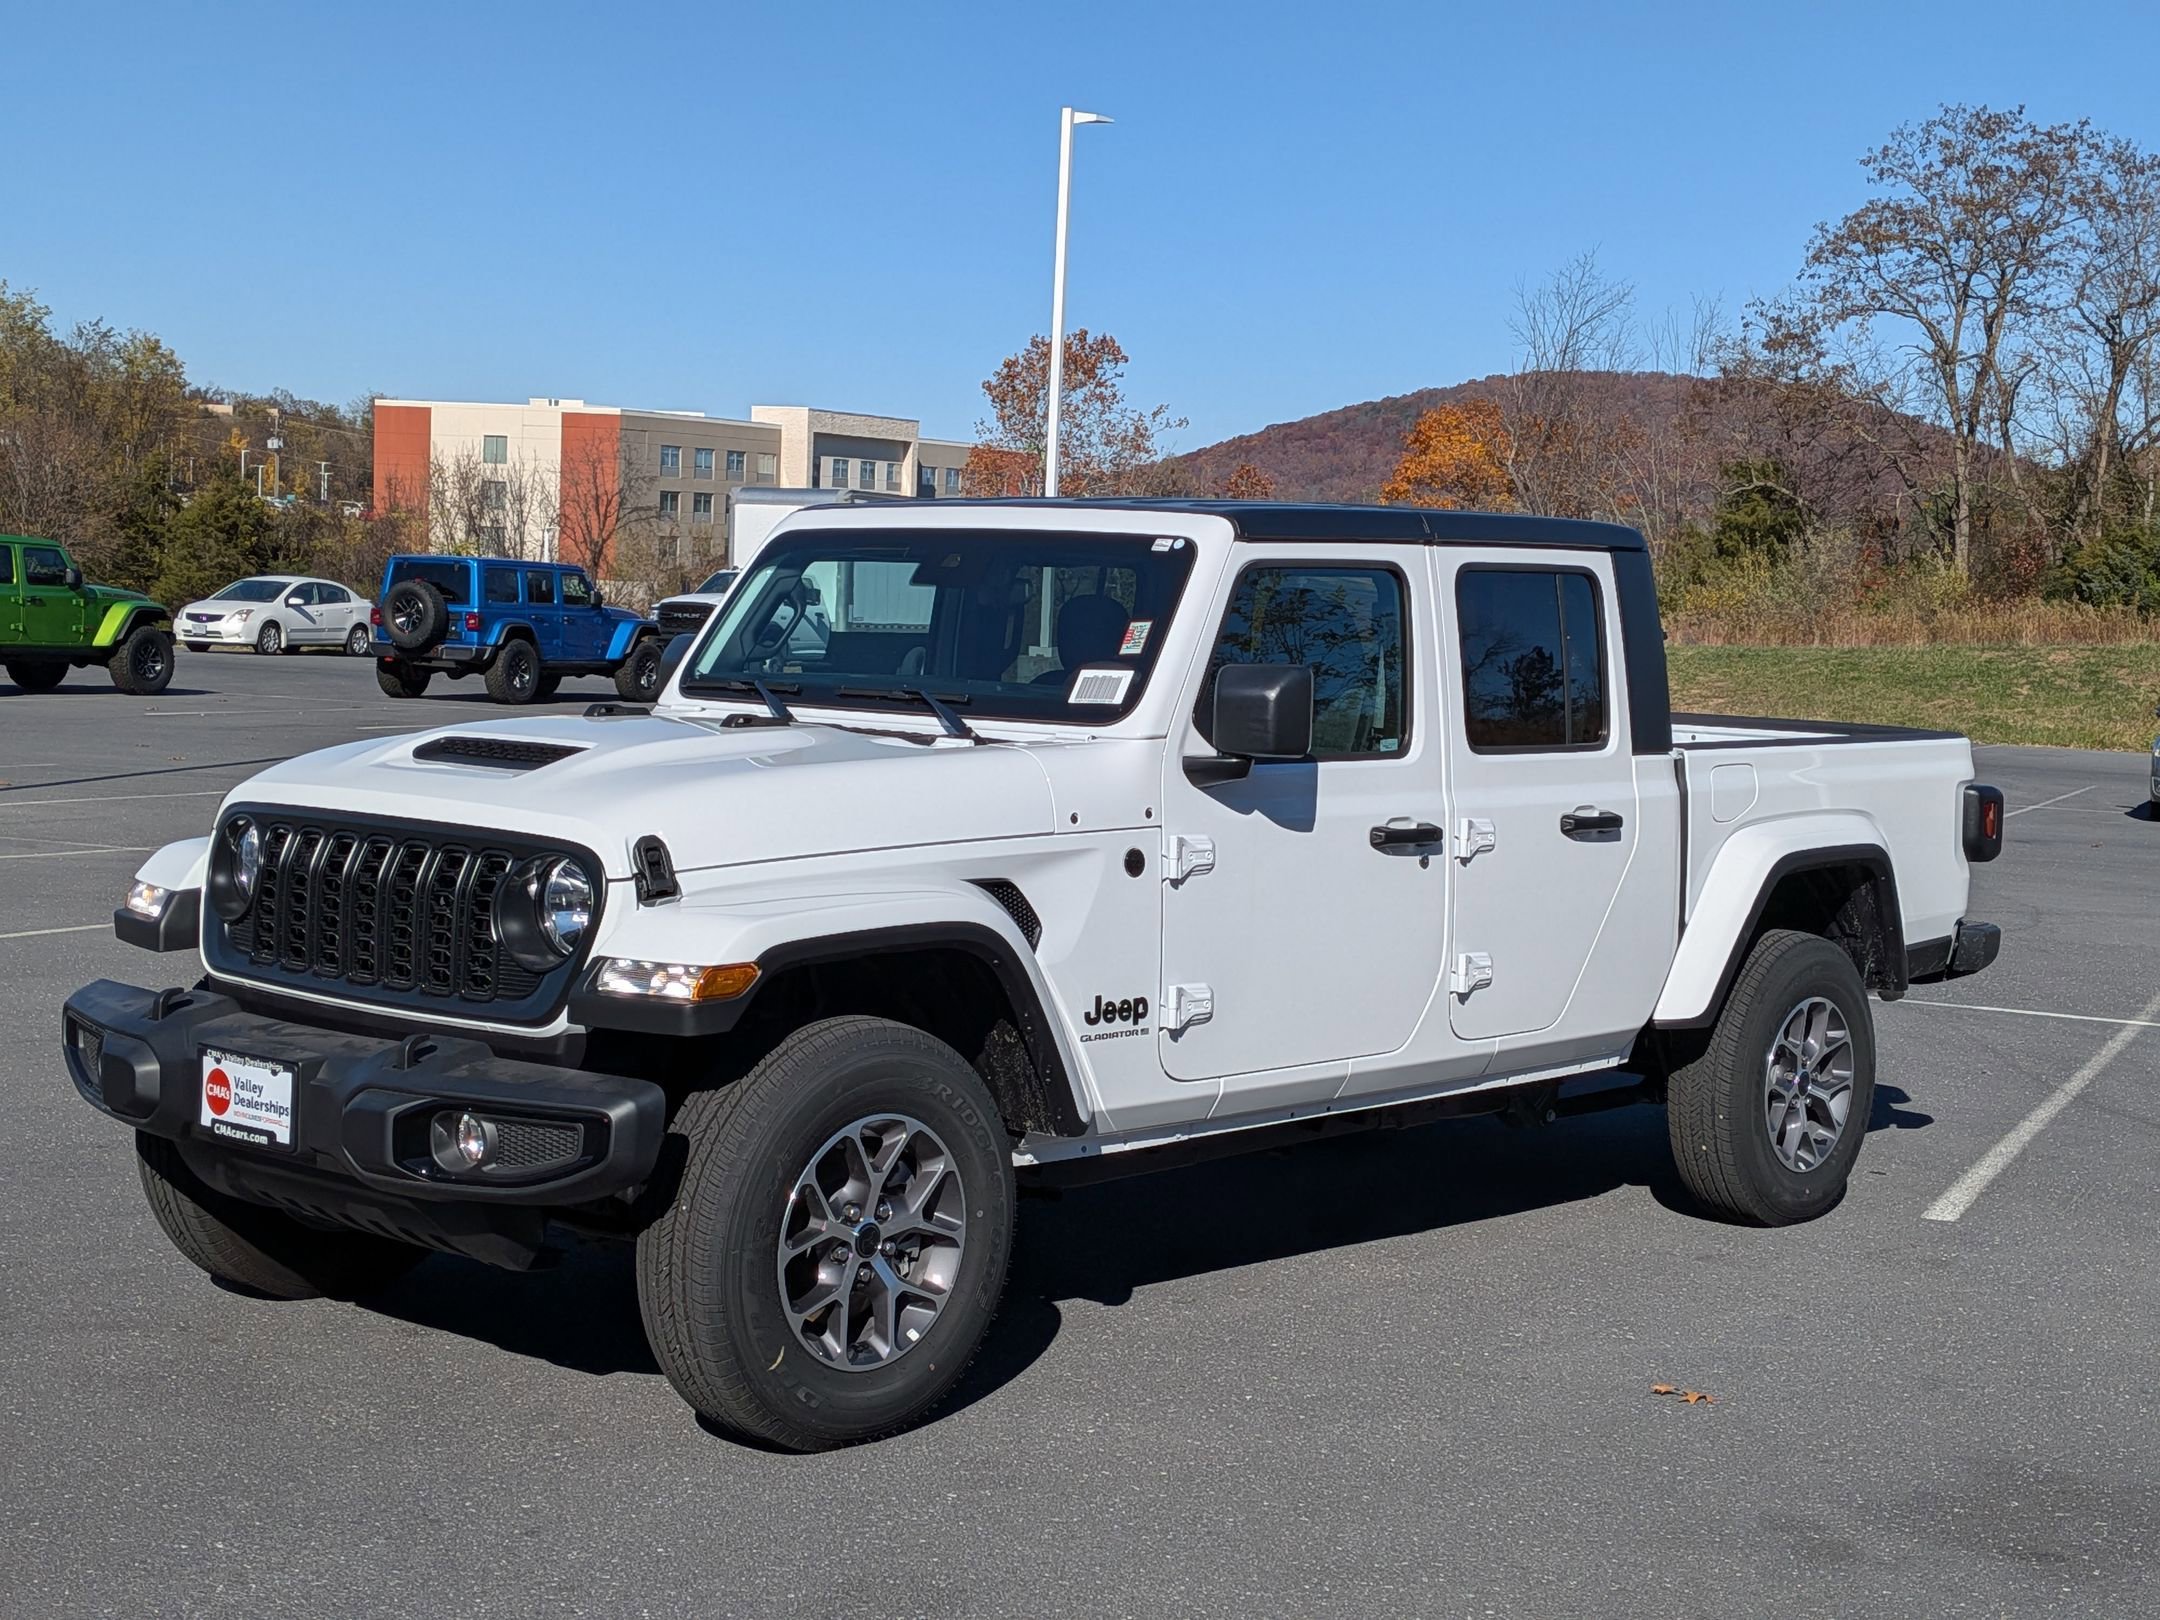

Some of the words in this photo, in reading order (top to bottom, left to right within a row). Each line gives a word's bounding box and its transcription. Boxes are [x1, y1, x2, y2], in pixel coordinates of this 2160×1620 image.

[1084, 995, 1149, 1026] Jeep
[1080, 1029, 1139, 1042] GLADIATOR
[225, 1053, 245, 1067] Valley
[245, 1057, 284, 1072] Dealerships
[234, 1076, 264, 1097] Valley
[234, 1093, 290, 1118] Dealerships
[214, 1123, 268, 1145] CMAcars.com
